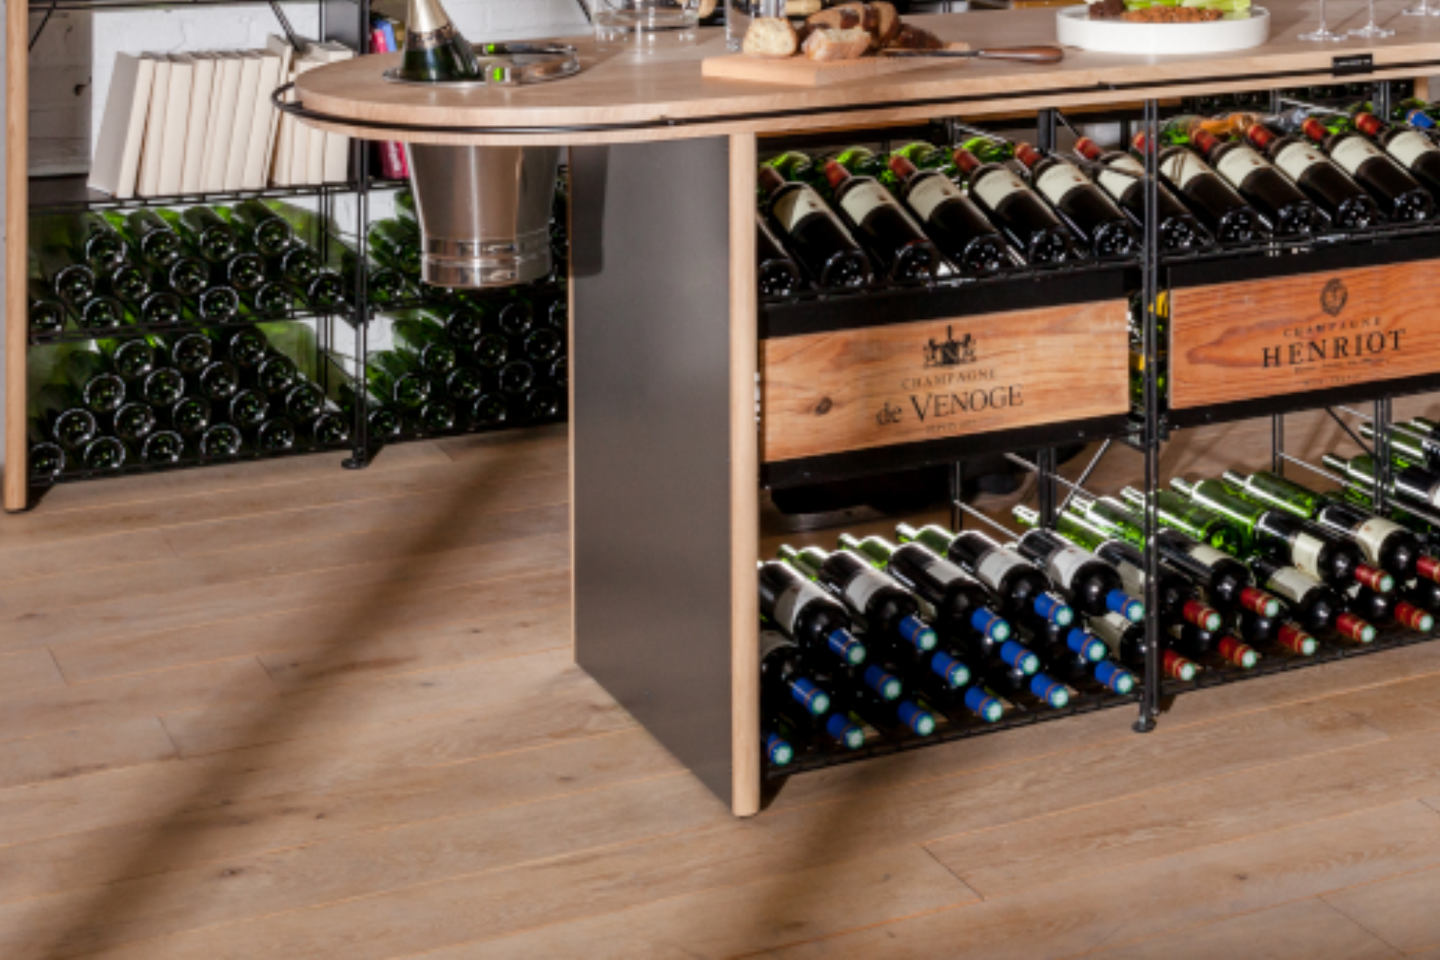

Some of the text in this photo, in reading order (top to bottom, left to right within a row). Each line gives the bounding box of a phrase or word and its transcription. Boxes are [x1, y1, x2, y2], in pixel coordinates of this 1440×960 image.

[1283, 316, 1382, 338] CHAMPAGNE
[1262, 328, 1407, 369] HENRIOT
[901, 368, 996, 390] CHAMPAGNE
[876, 384, 1024, 426] de VENOGE
